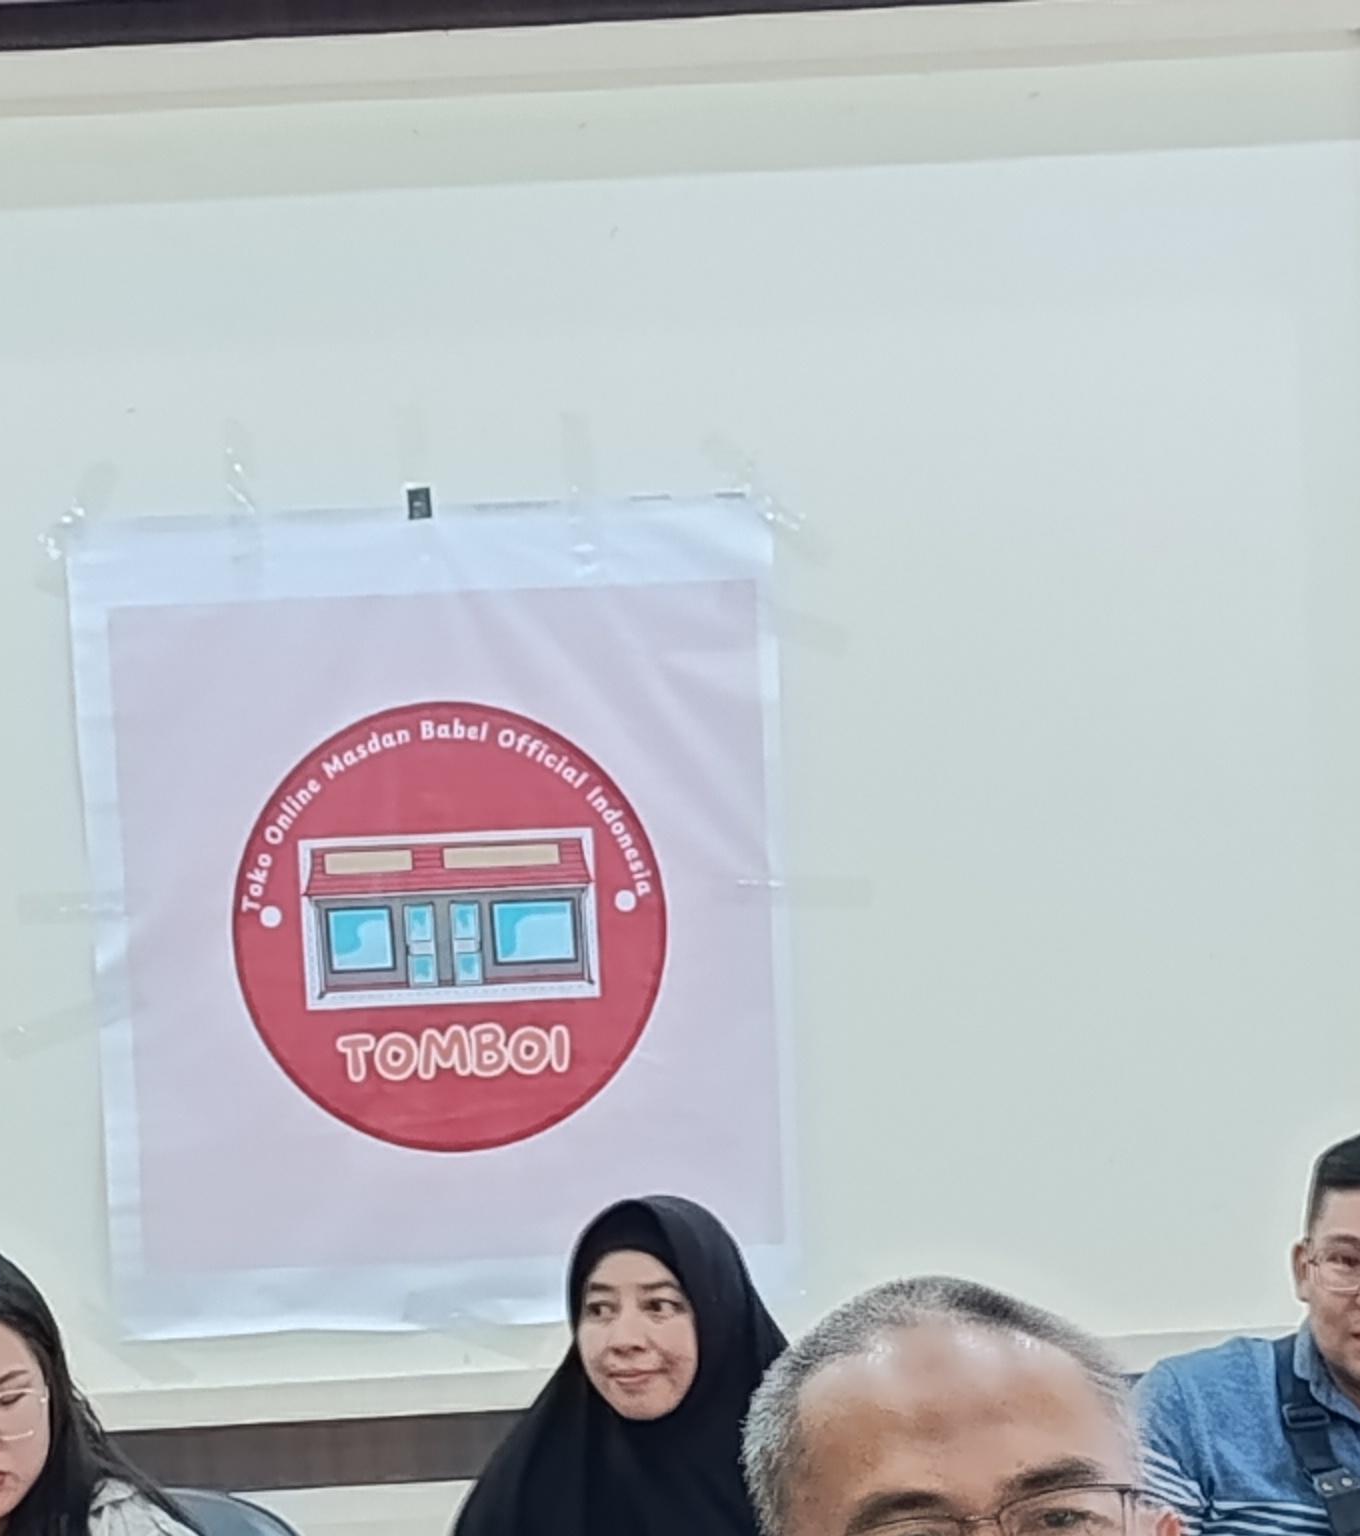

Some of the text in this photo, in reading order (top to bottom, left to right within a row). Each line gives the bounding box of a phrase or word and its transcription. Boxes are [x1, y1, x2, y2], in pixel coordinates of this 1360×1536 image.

[241, 718, 652, 912] Toko Online Masdan Babel Official Indonesia
[336, 1022, 570, 1082] TOMBOI
